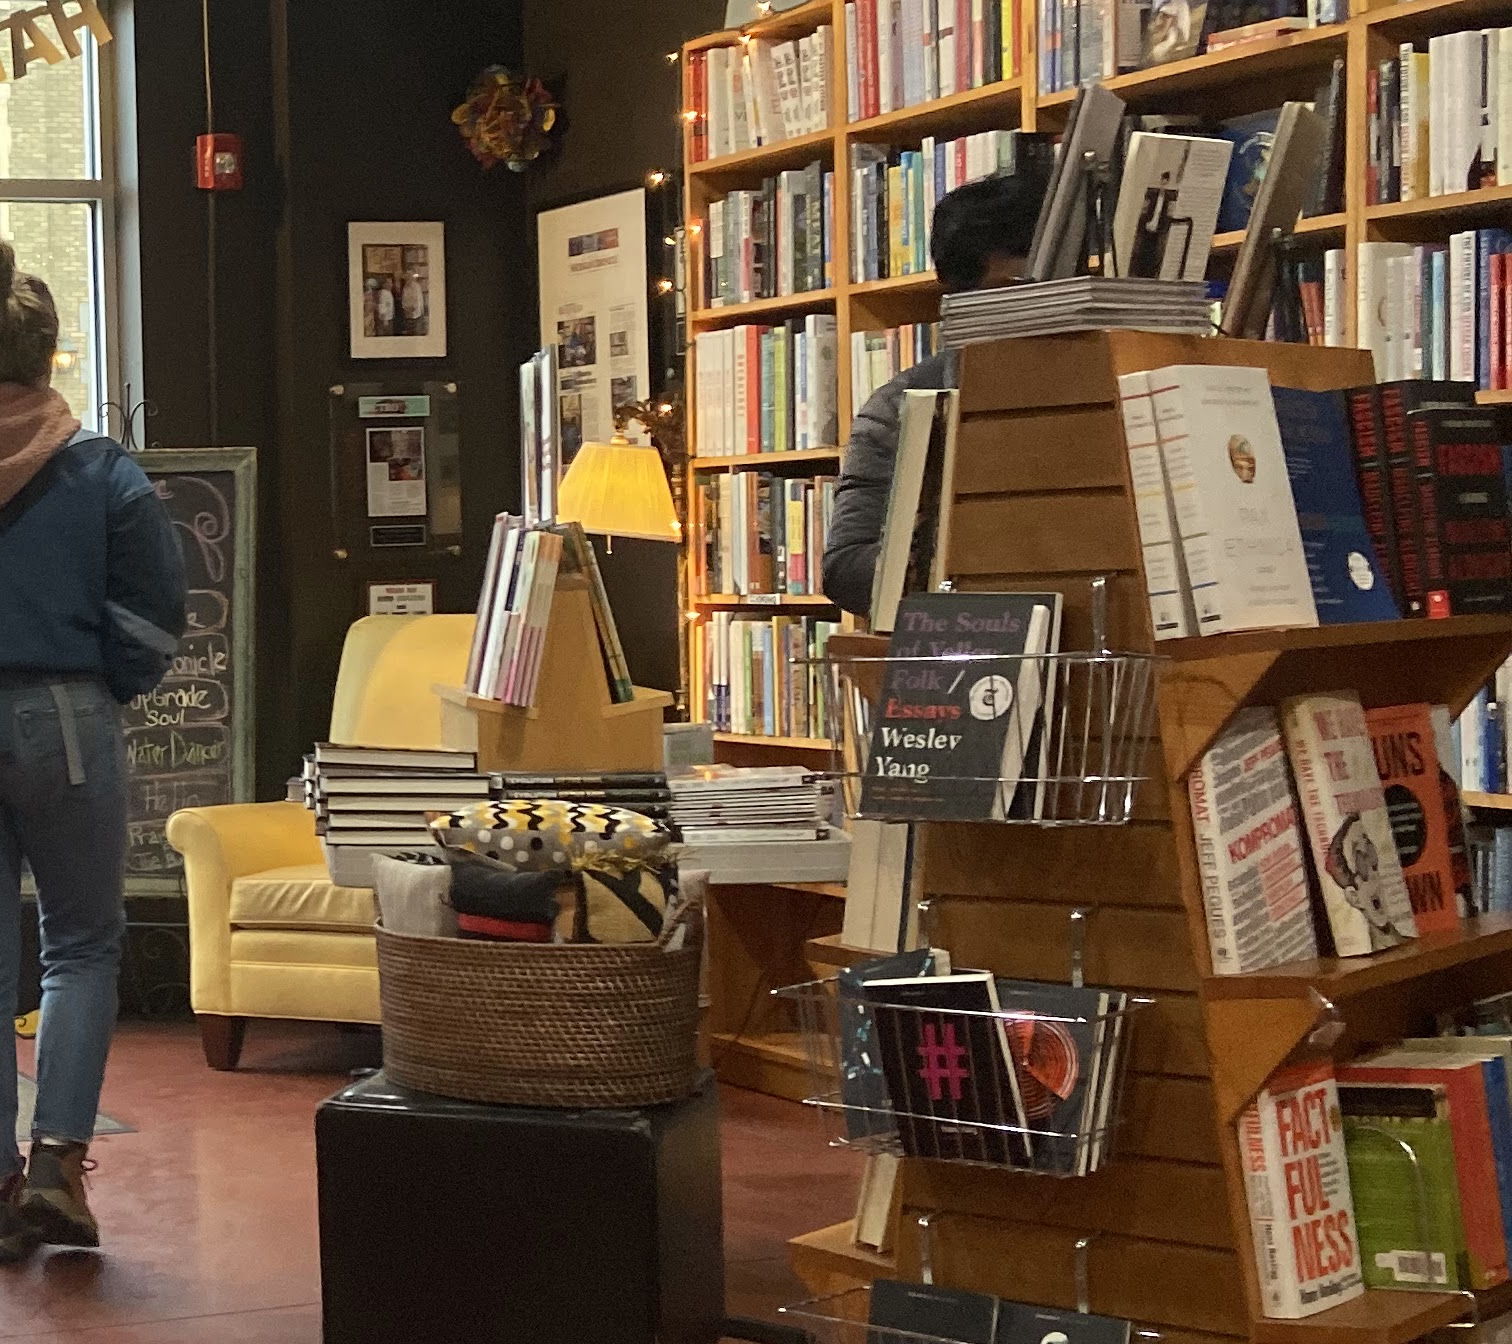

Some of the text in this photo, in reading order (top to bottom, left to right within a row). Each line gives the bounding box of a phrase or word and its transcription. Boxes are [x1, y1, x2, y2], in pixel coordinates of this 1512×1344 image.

[903, 609, 1021, 634] The Souls
[890, 669, 941, 690] Folk
[145, 708, 186, 728] Soul
[885, 698, 962, 720] Essays
[880, 727, 962, 751] Wesley
[1371, 731, 1426, 781] UNS
[875, 757, 930, 783] Yang
[1199, 832, 1218, 871] JEFF
[1275, 1087, 1332, 1157] FACT
[1284, 1154, 1330, 1221] FUL
[1291, 1209, 1355, 1284] NESS
